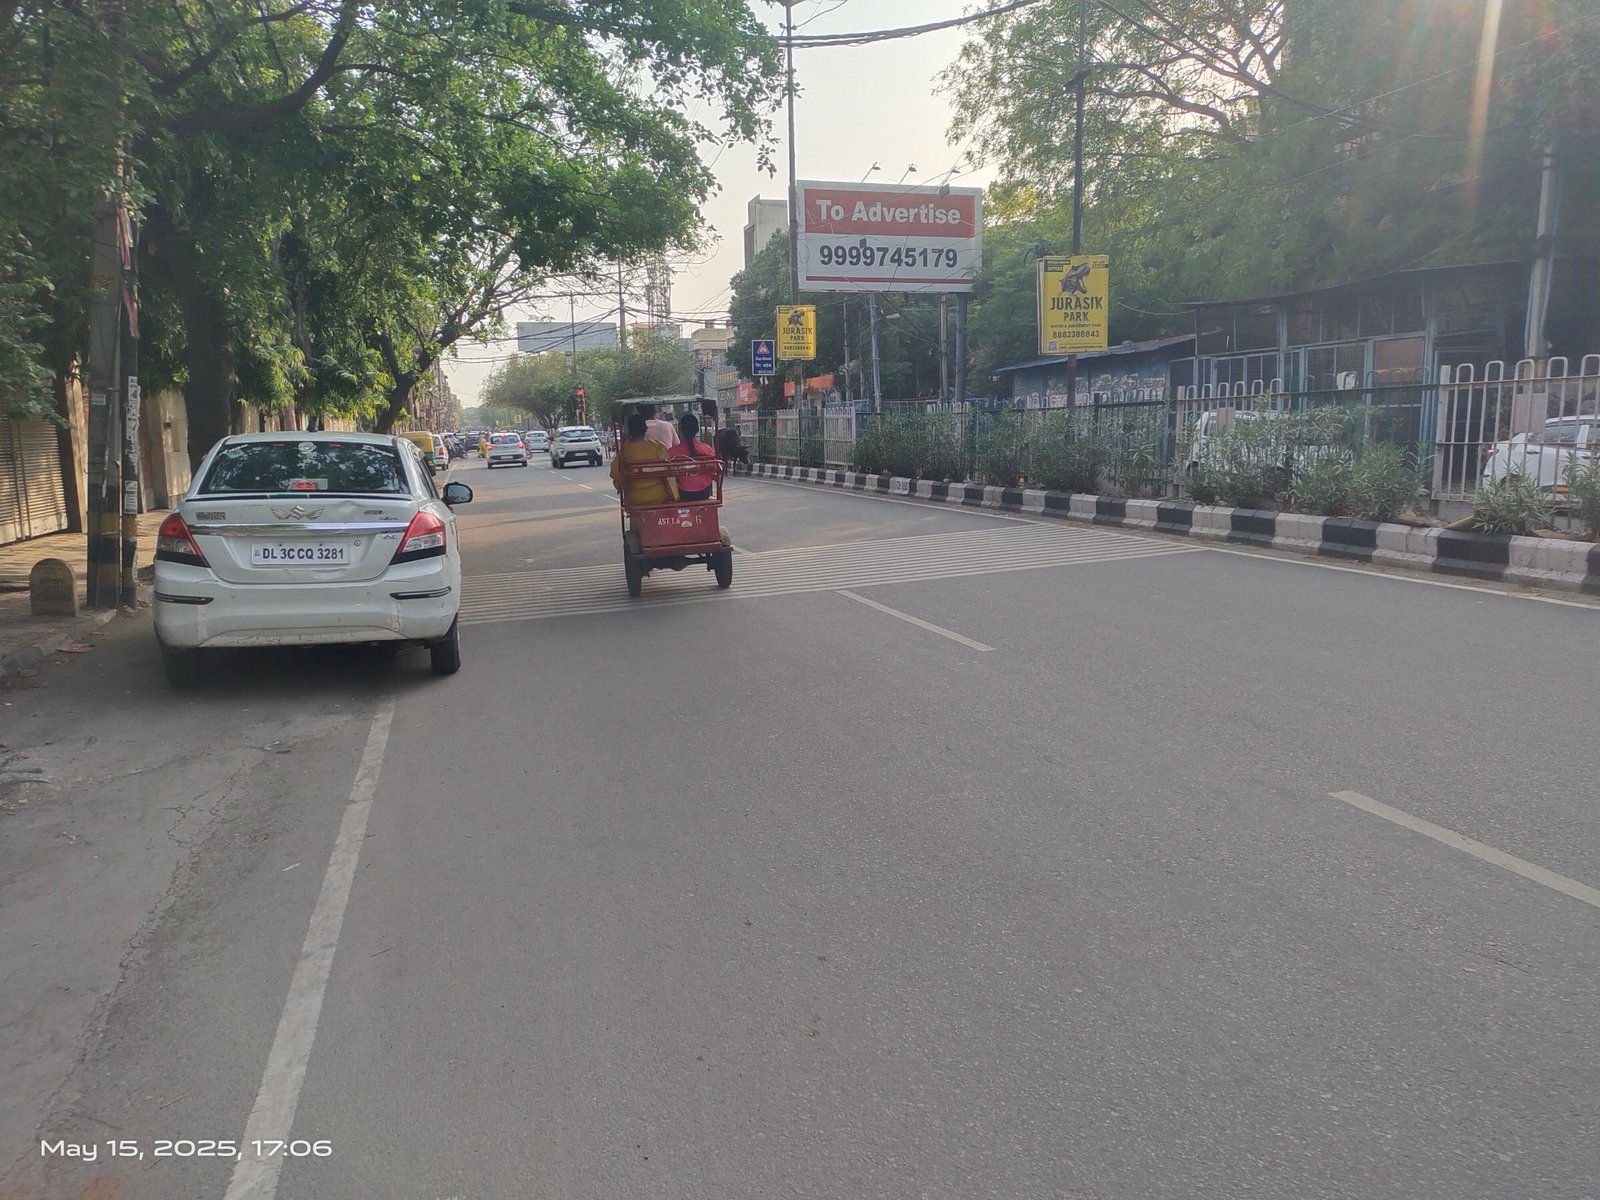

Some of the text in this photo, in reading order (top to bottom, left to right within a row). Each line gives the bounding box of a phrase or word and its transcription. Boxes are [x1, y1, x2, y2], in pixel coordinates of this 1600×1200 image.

[816, 200, 961, 225] To Advertise
[820, 245, 958, 269] 9999745179
[1050, 296, 1104, 311] JURASIK
[1064, 311, 1089, 322] PARK
[782, 327, 813, 335] JURASIK
[1052, 330, 1100, 339] 8882388843
[262, 547, 278, 560] DL
[280, 547, 295, 560] 3C
[297, 547, 314, 560] CQ
[316, 547, 344, 560] 3281
